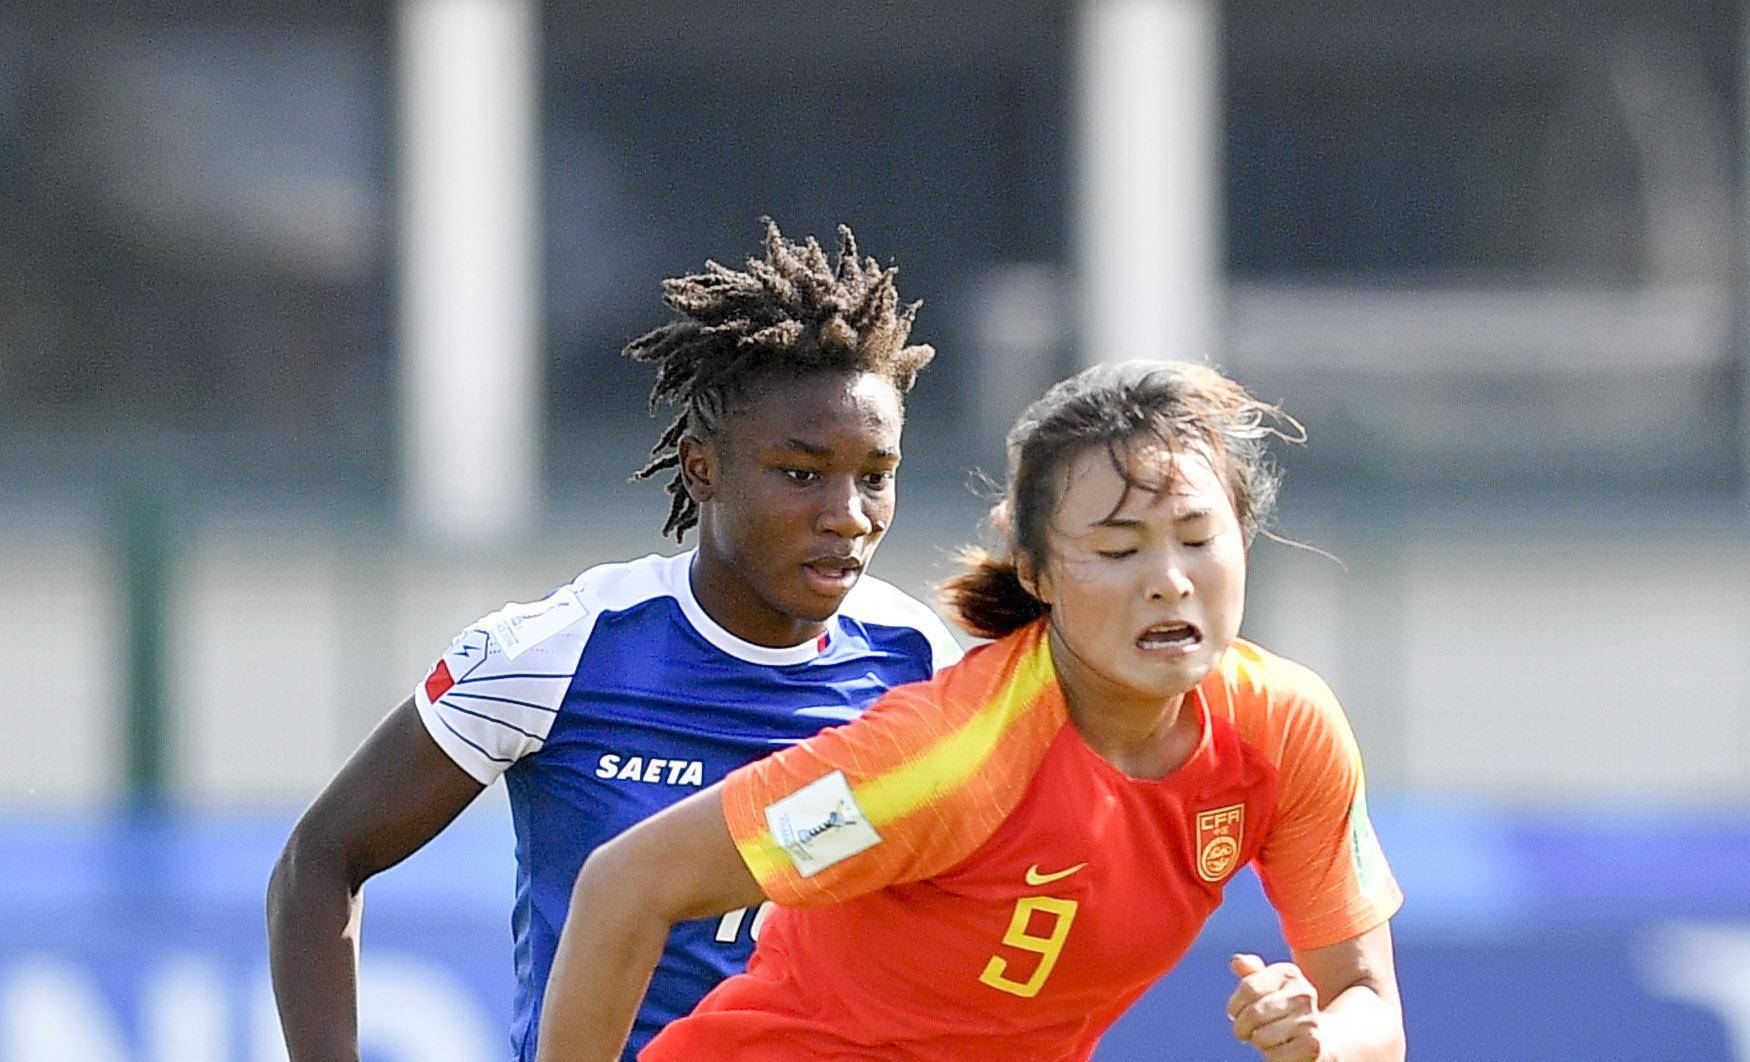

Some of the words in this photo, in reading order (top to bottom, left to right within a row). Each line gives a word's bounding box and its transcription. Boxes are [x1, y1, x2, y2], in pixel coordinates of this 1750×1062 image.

[596, 754, 702, 786] SAETA
[1201, 810, 1240, 831] CFA
[979, 896, 1078, 998] 9
